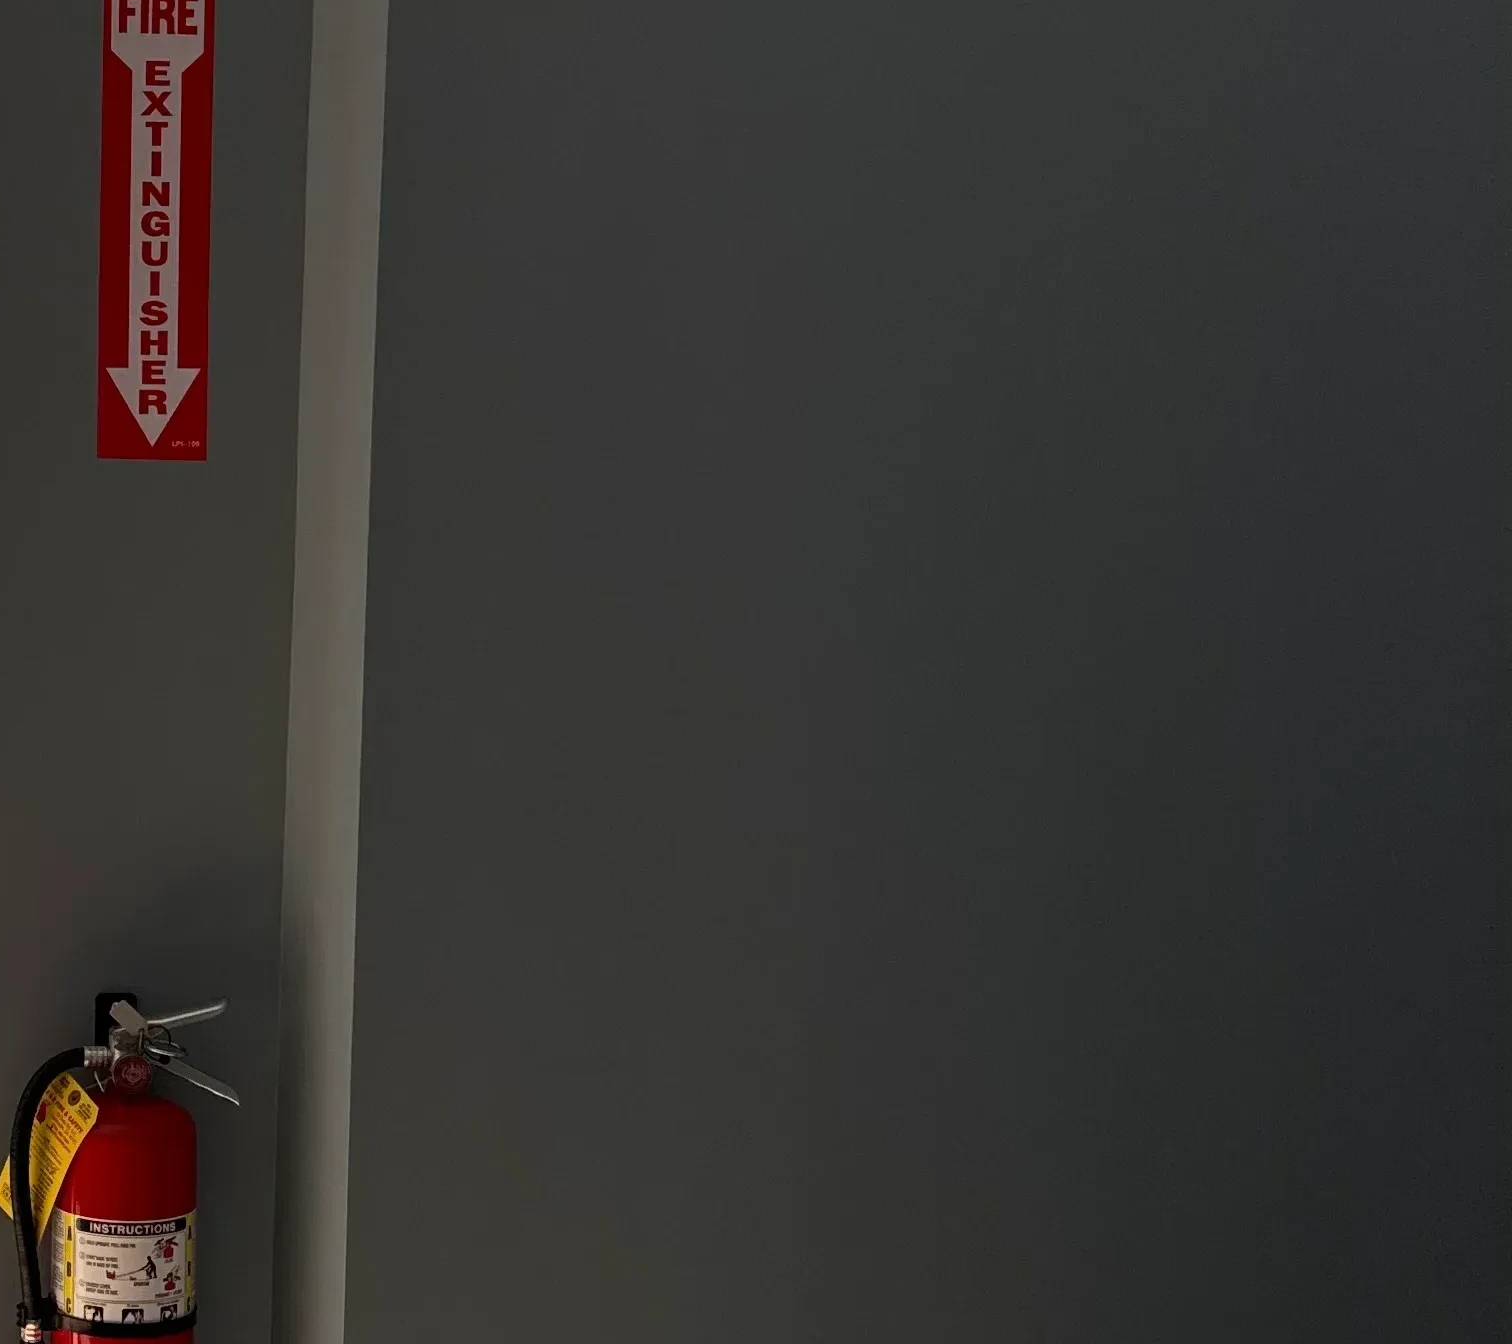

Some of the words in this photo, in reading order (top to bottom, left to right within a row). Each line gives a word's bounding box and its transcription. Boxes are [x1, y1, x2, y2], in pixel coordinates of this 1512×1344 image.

[139, 60, 173, 416] EXTINGUISHER
[66, 1226, 72, 1241] A
[89, 1221, 177, 1236] INSTRUCTIONS
[66, 1261, 72, 1277] B
